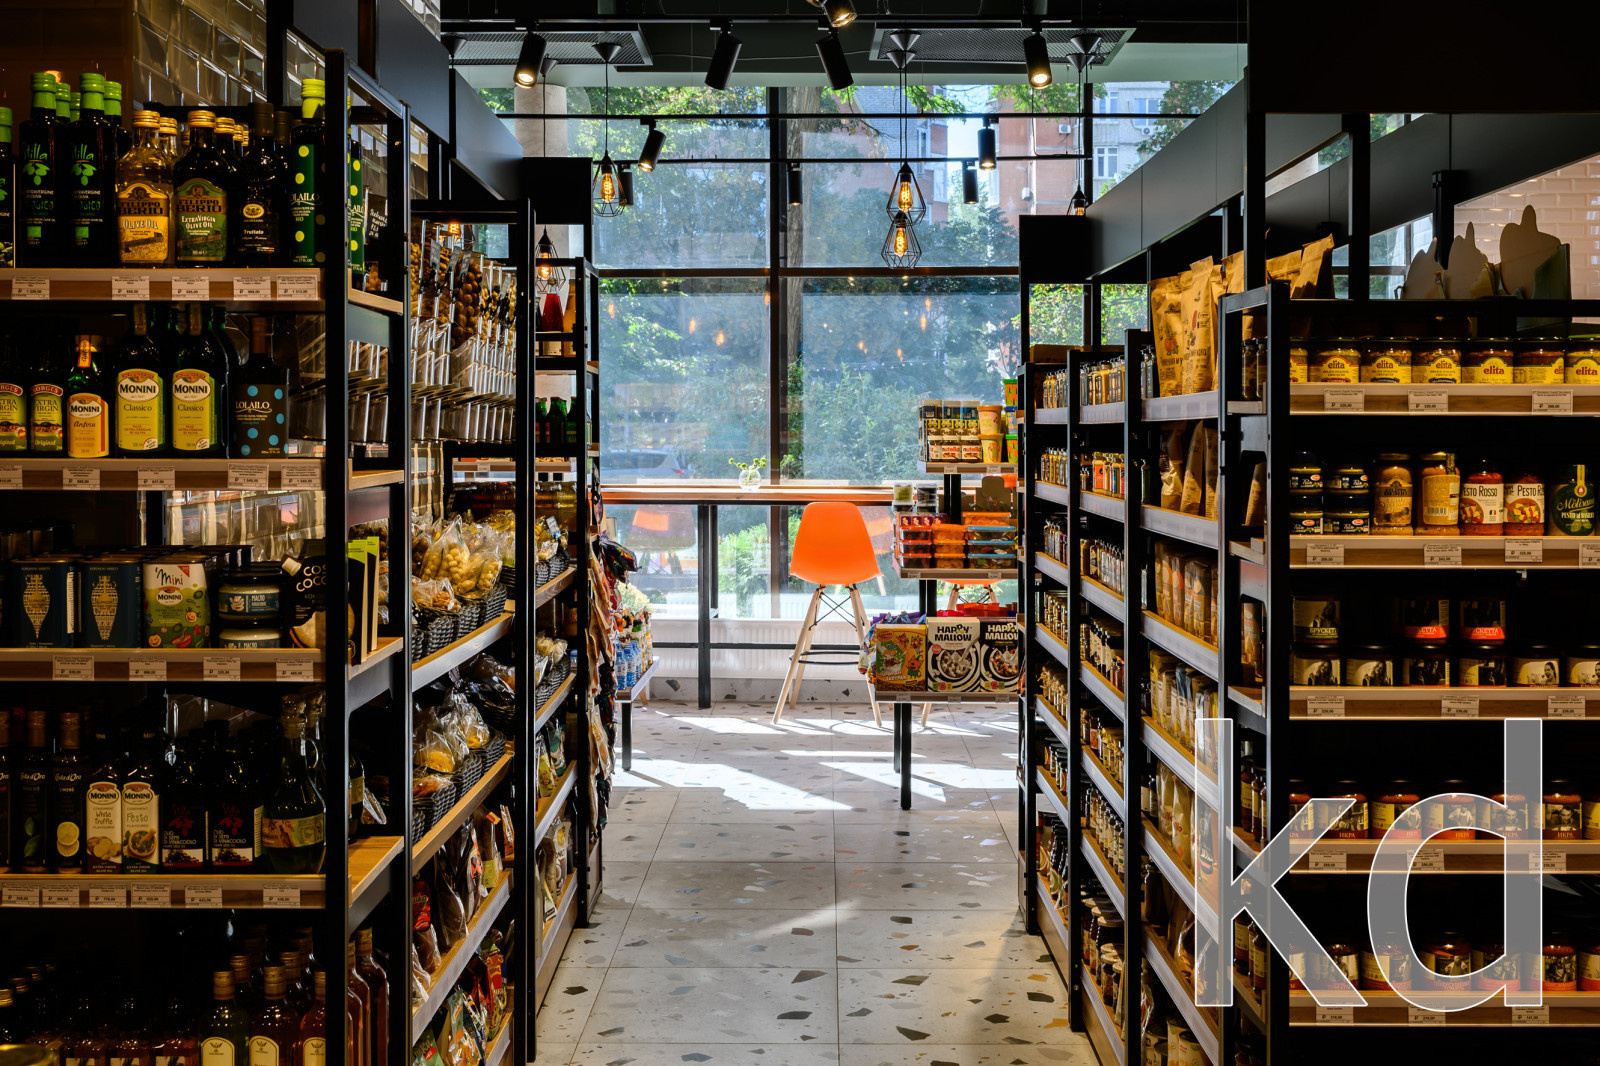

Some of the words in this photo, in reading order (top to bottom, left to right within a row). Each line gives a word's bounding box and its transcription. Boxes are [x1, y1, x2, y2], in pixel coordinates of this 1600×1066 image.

[1327, 360, 1345, 369] elita
[1376, 360, 1394, 369] elita
[1435, 360, 1453, 370] elita
[1483, 365, 1505, 375] elita
[1575, 365, 1598, 376] elita
[0, 386, 19, 395] RGES
[120, 383, 156, 393] MONINI
[175, 383, 208, 393] MONINI
[124, 404, 153, 412] Classico
[178, 404, 204, 412] Classico
[1463, 487, 1477, 496] ESTO
[937, 624, 969, 634] HAPPY
[127, 812, 149, 823] Pesto
